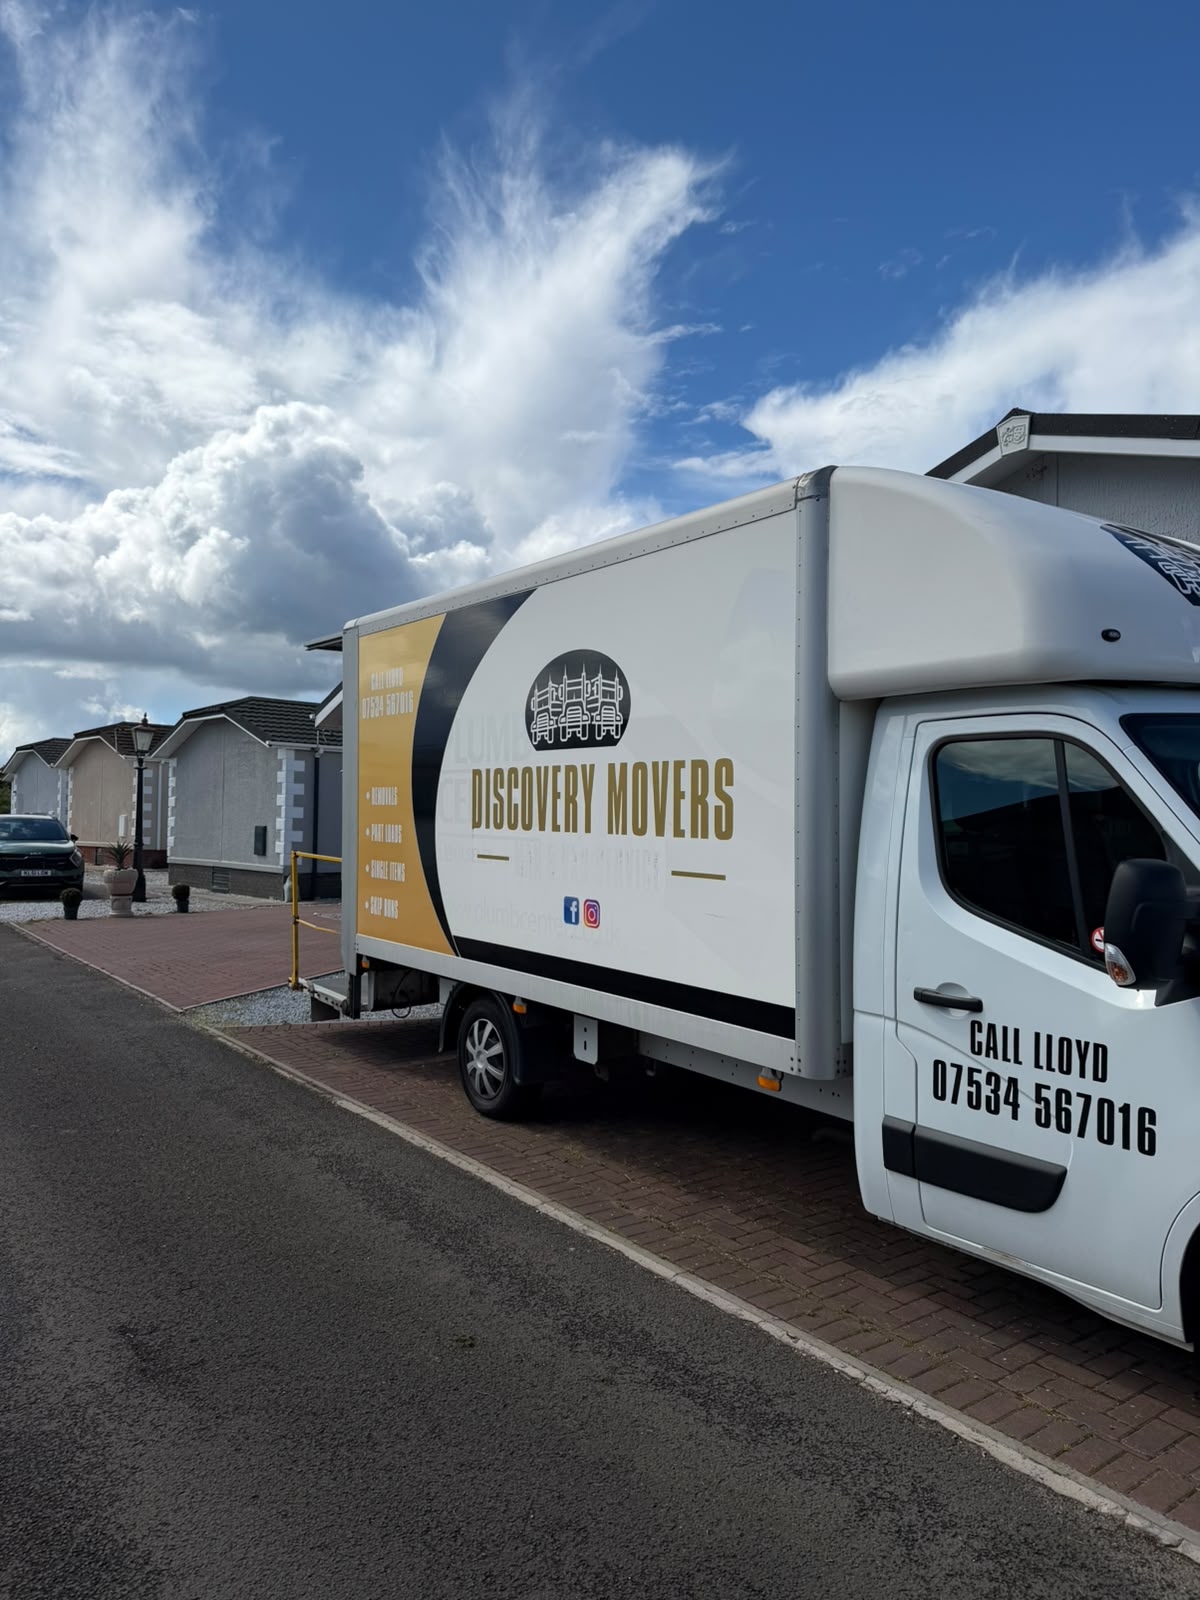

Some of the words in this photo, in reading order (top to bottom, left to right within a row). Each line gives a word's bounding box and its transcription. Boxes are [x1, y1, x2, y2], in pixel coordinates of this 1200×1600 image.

[361, 695, 384, 720] 07534
[386, 690, 414, 716] 567016
[471, 763, 595, 834] DISCOVERY
[607, 758, 735, 841] MOVERS
[370, 859, 388, 880] SINGLE
[389, 861, 406, 883] ITEMS
[370, 895, 383, 916] SKIP
[970, 1019, 1023, 1066] CALL
[1033, 1031, 1109, 1084] LLOYD
[932, 1058, 1021, 1121] 07534
[1034, 1082, 1157, 1157] 567016
